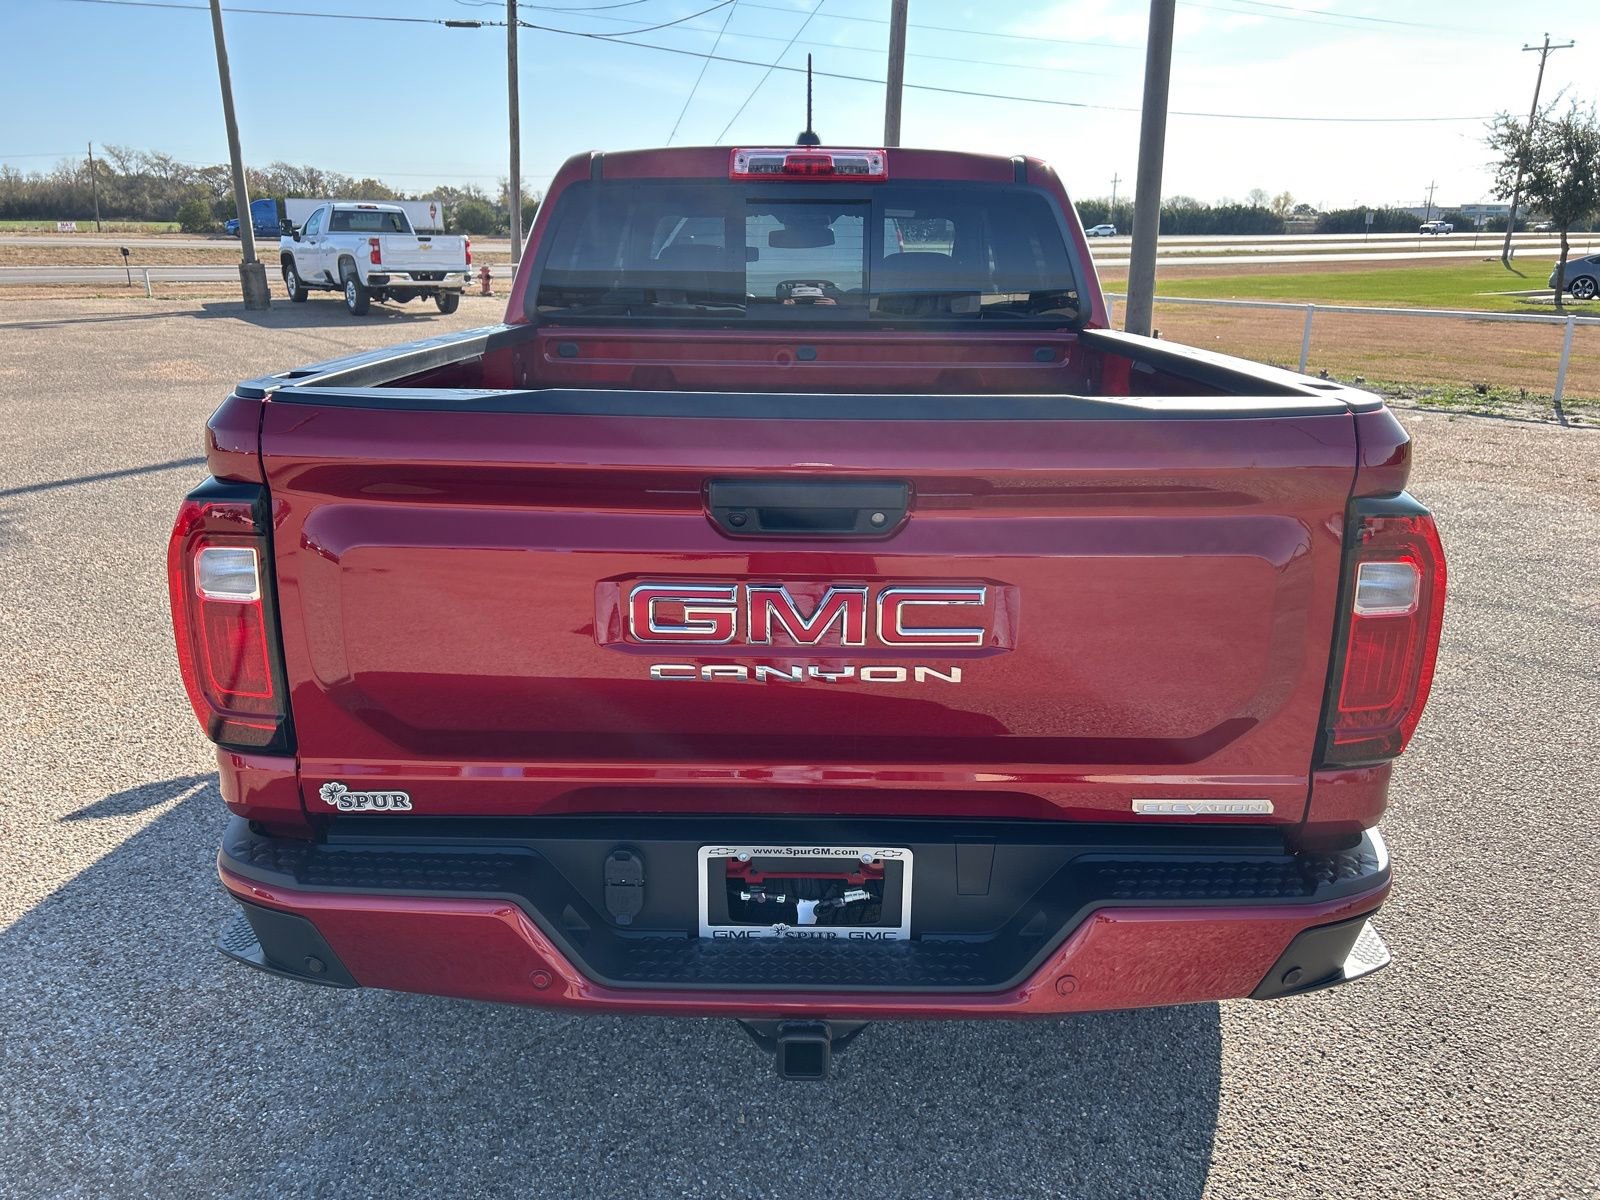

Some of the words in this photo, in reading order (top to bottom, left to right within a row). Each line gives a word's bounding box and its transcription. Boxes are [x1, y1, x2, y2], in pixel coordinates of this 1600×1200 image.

[629, 583, 987, 646] GMC
[649, 663, 962, 683] CANYON
[339, 794, 409, 808] SPUR
[1142, 803, 1264, 813] ELEVATION
[752, 847, 859, 857] www.SpurGM.com
[712, 930, 761, 939] GMC
[848, 931, 897, 940] GMC
